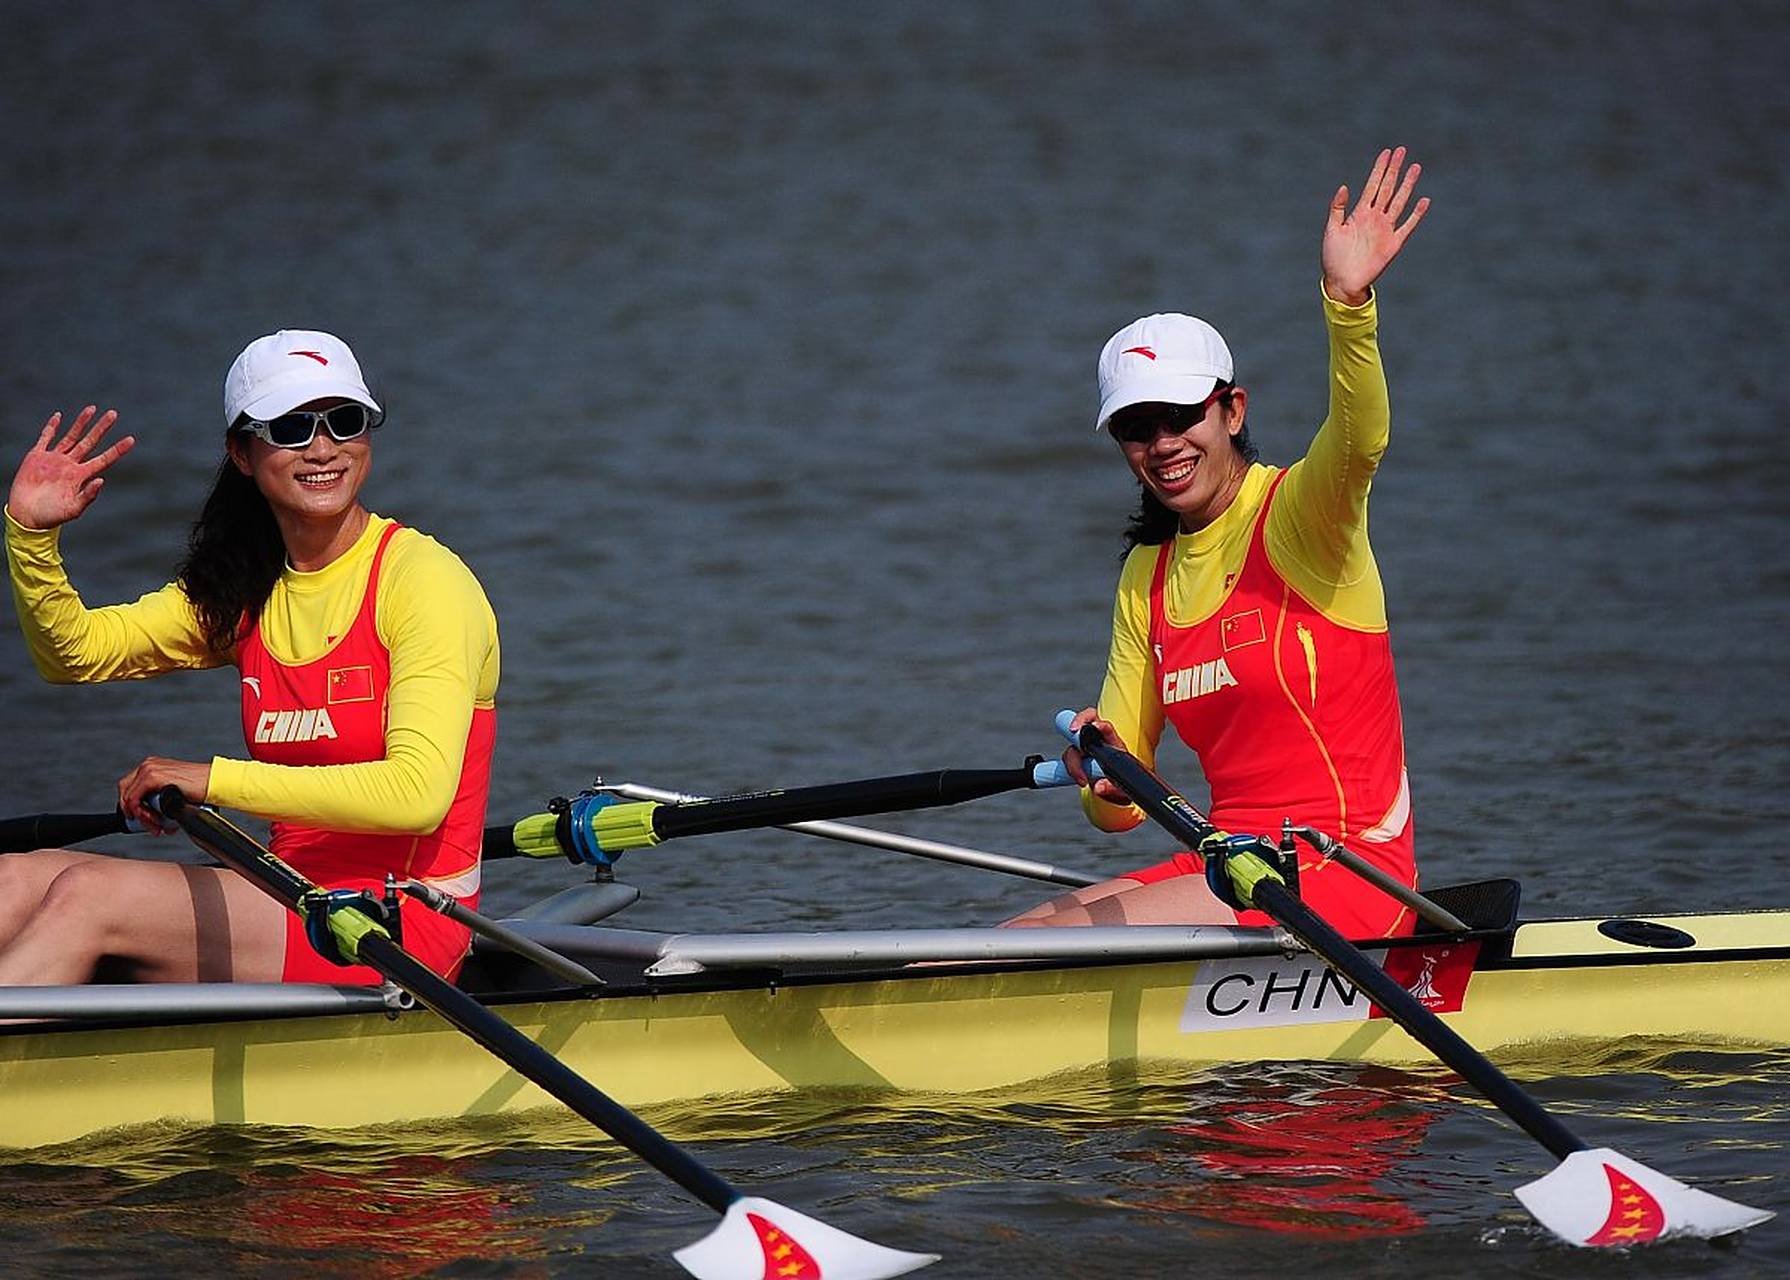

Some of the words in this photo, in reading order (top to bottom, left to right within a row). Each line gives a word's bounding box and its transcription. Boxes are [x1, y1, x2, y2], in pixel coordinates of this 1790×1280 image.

[1163, 656, 1239, 705] CHINA
[254, 707, 338, 743] CHINA
[1205, 967, 1357, 1017] CHN
